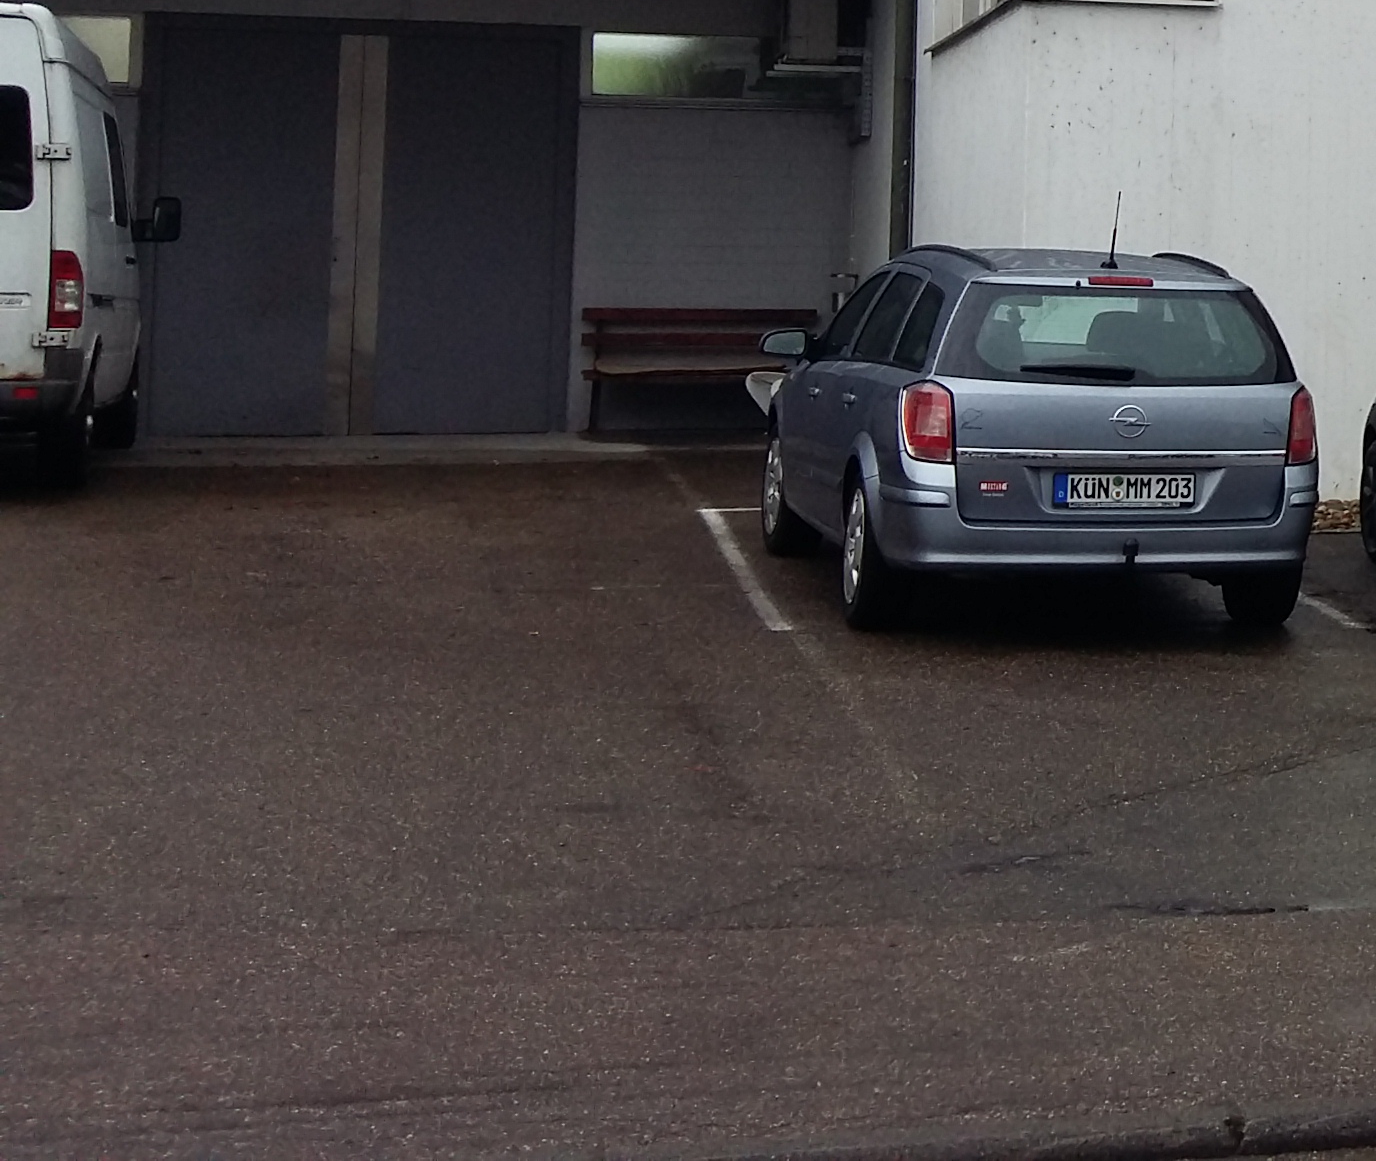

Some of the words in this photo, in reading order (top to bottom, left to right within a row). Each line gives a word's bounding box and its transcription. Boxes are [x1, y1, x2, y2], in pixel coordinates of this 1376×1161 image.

[1070, 477, 1110, 499] KÜN
[1125, 477, 1151, 499] MM
[1155, 477, 1191, 499] 203
